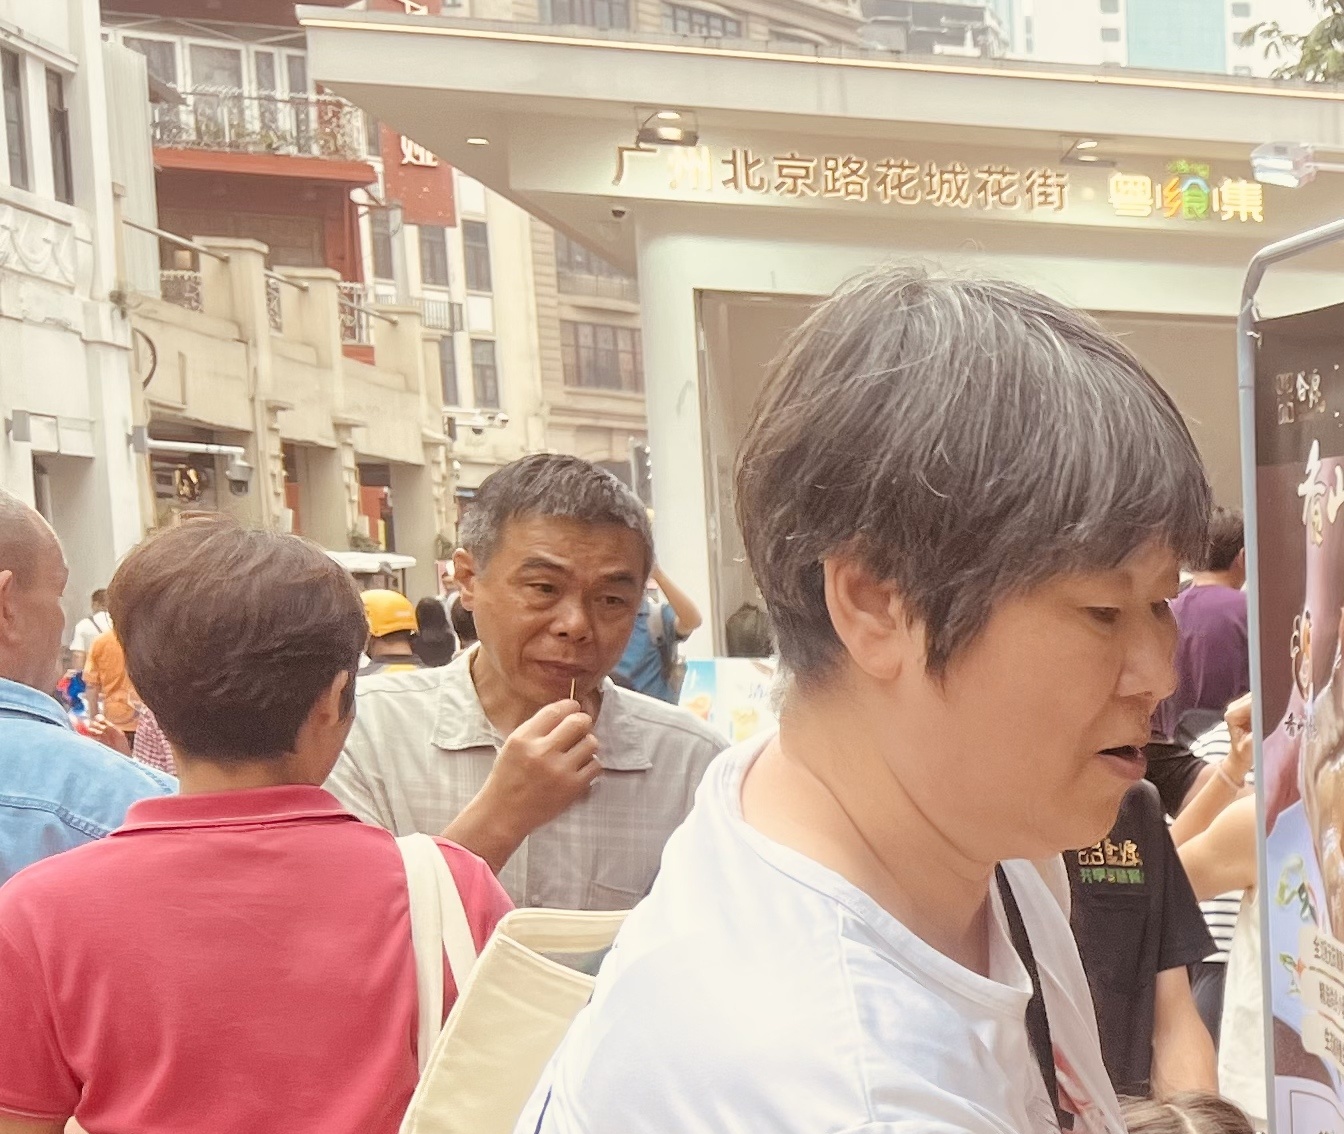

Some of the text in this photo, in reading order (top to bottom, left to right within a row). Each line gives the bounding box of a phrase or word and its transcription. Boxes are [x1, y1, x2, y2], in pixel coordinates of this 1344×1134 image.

[611, 144, 1071, 213] 广州北京路花城花街
